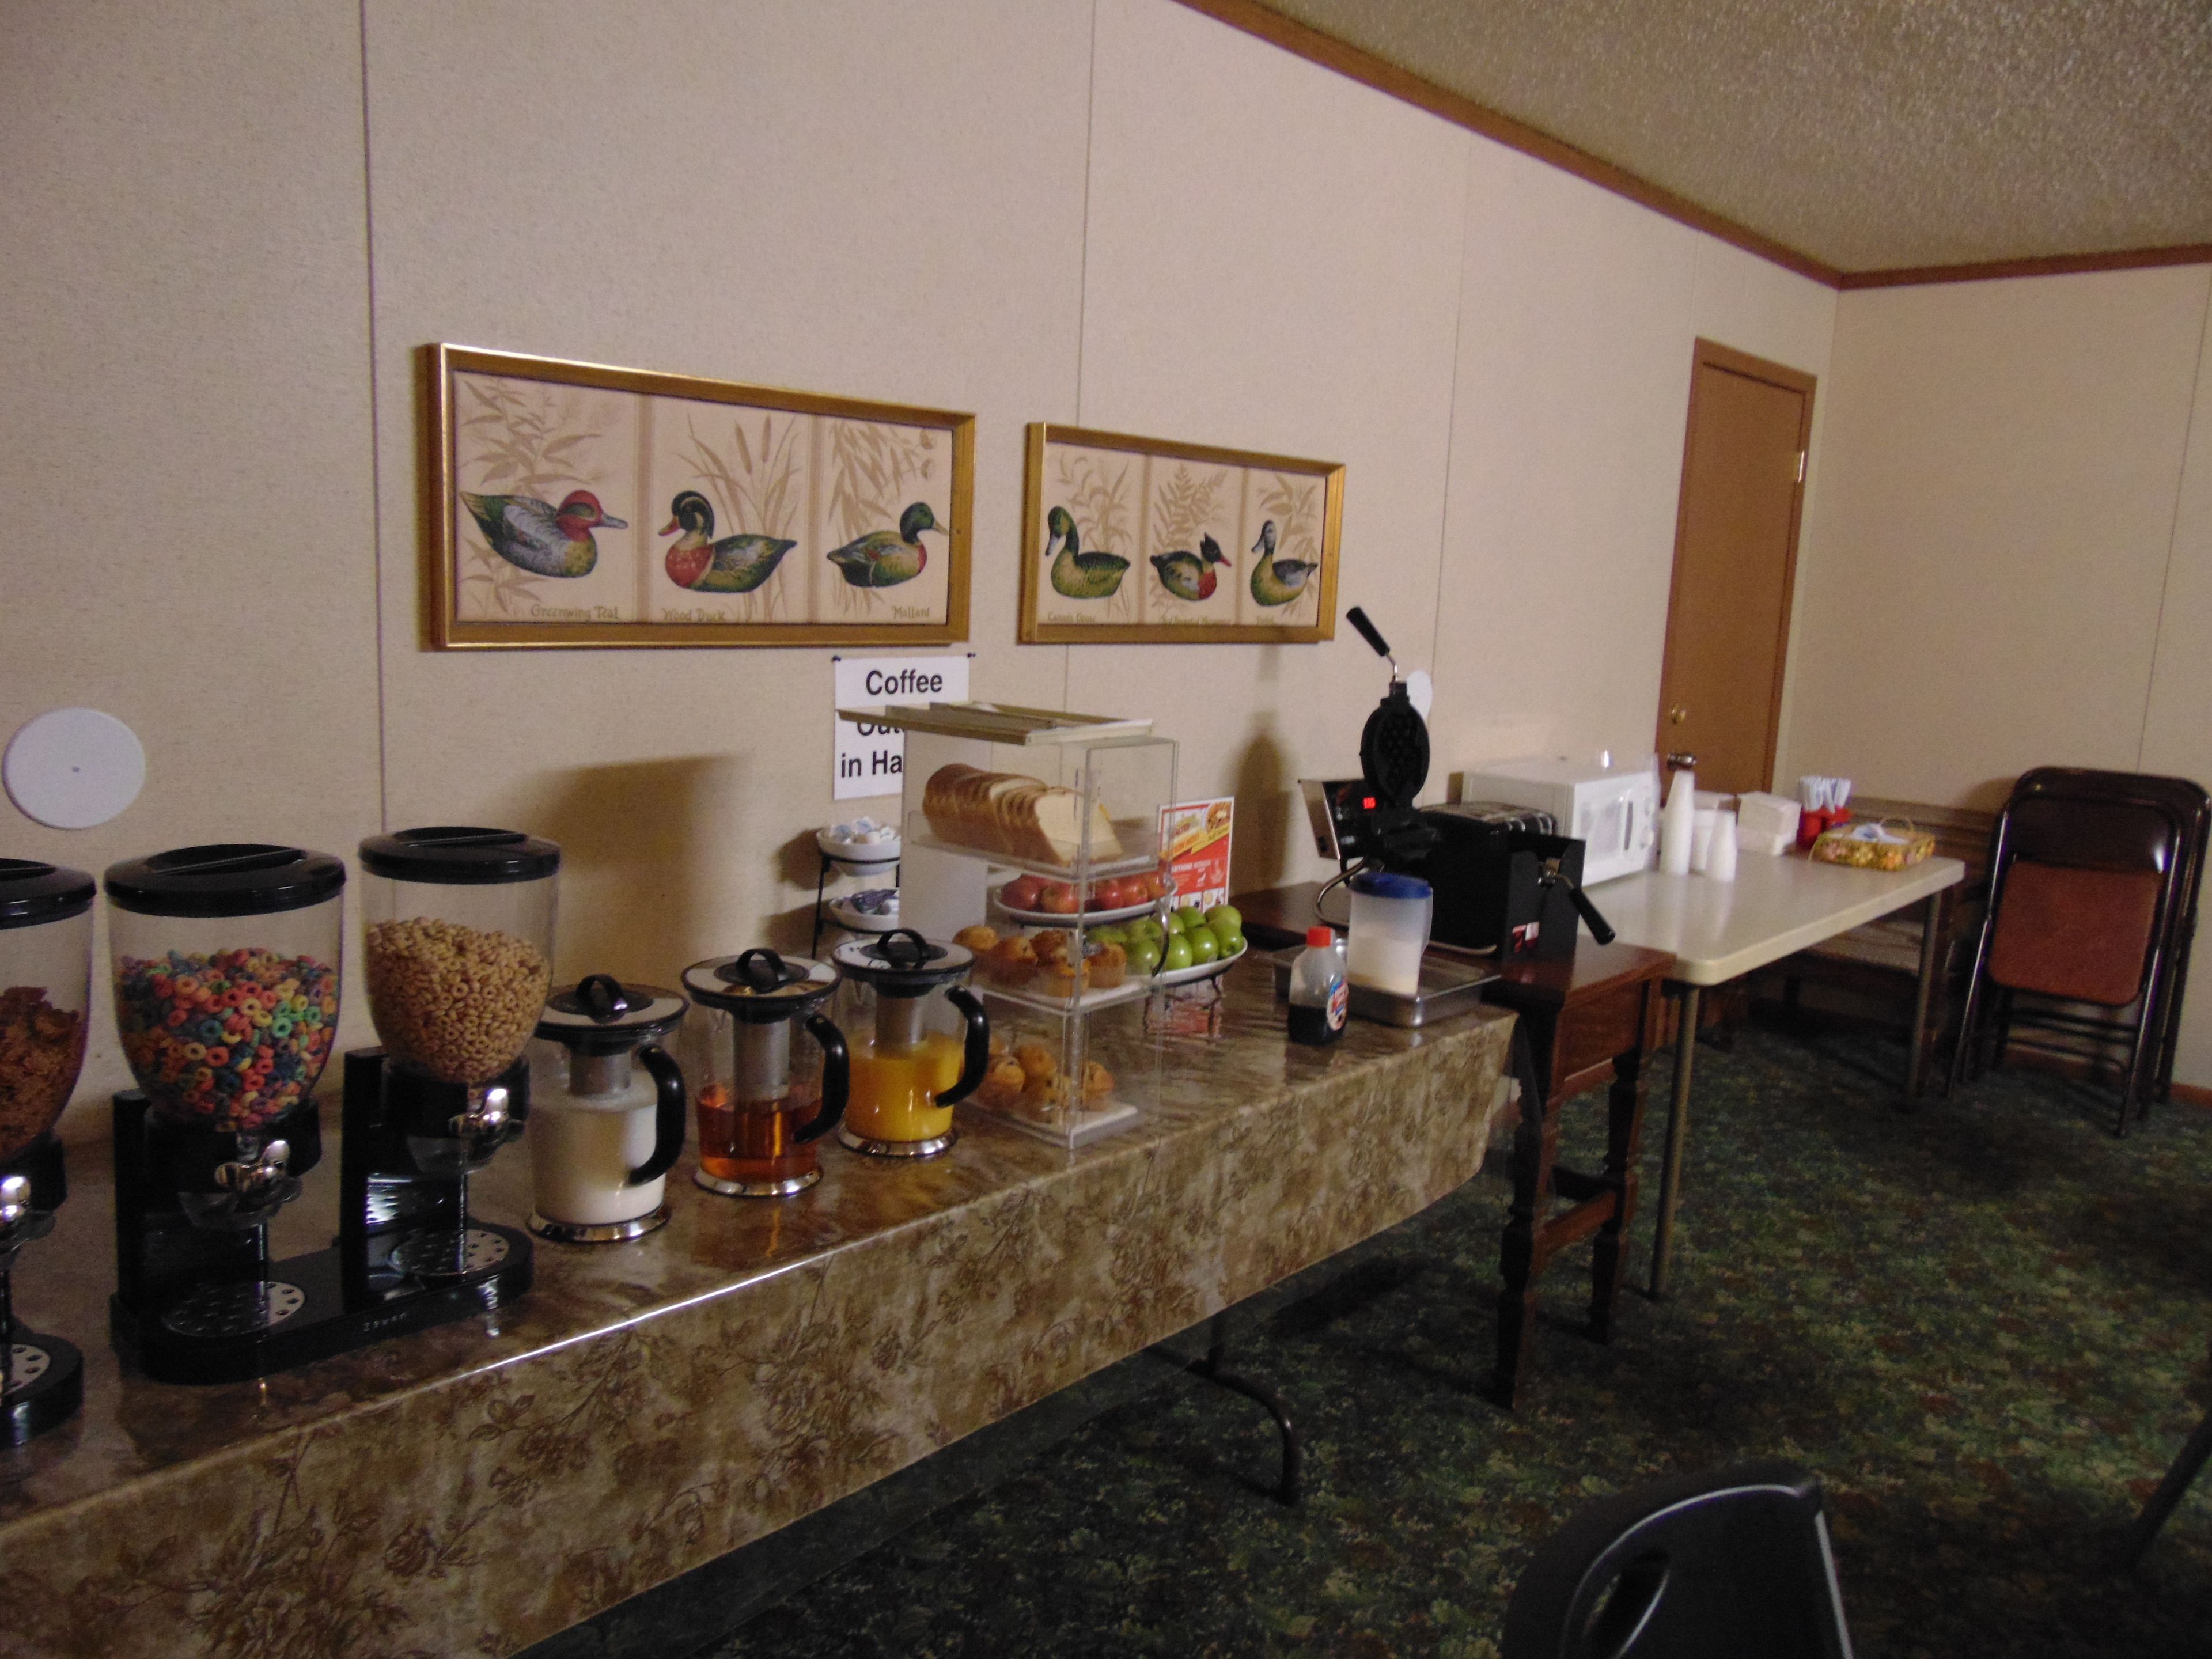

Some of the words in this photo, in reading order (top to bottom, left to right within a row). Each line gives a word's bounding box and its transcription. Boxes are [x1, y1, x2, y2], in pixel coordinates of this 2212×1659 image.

[531, 604, 591, 622] Greenwing
[594, 605, 620, 620] Teal
[660, 607, 692, 622] Wood
[695, 607, 726, 622] Duck
[891, 605, 930, 619] Mallard
[866, 669, 943, 695] Coffee
[841, 752, 862, 778] in
[872, 749, 903, 775] Ha
